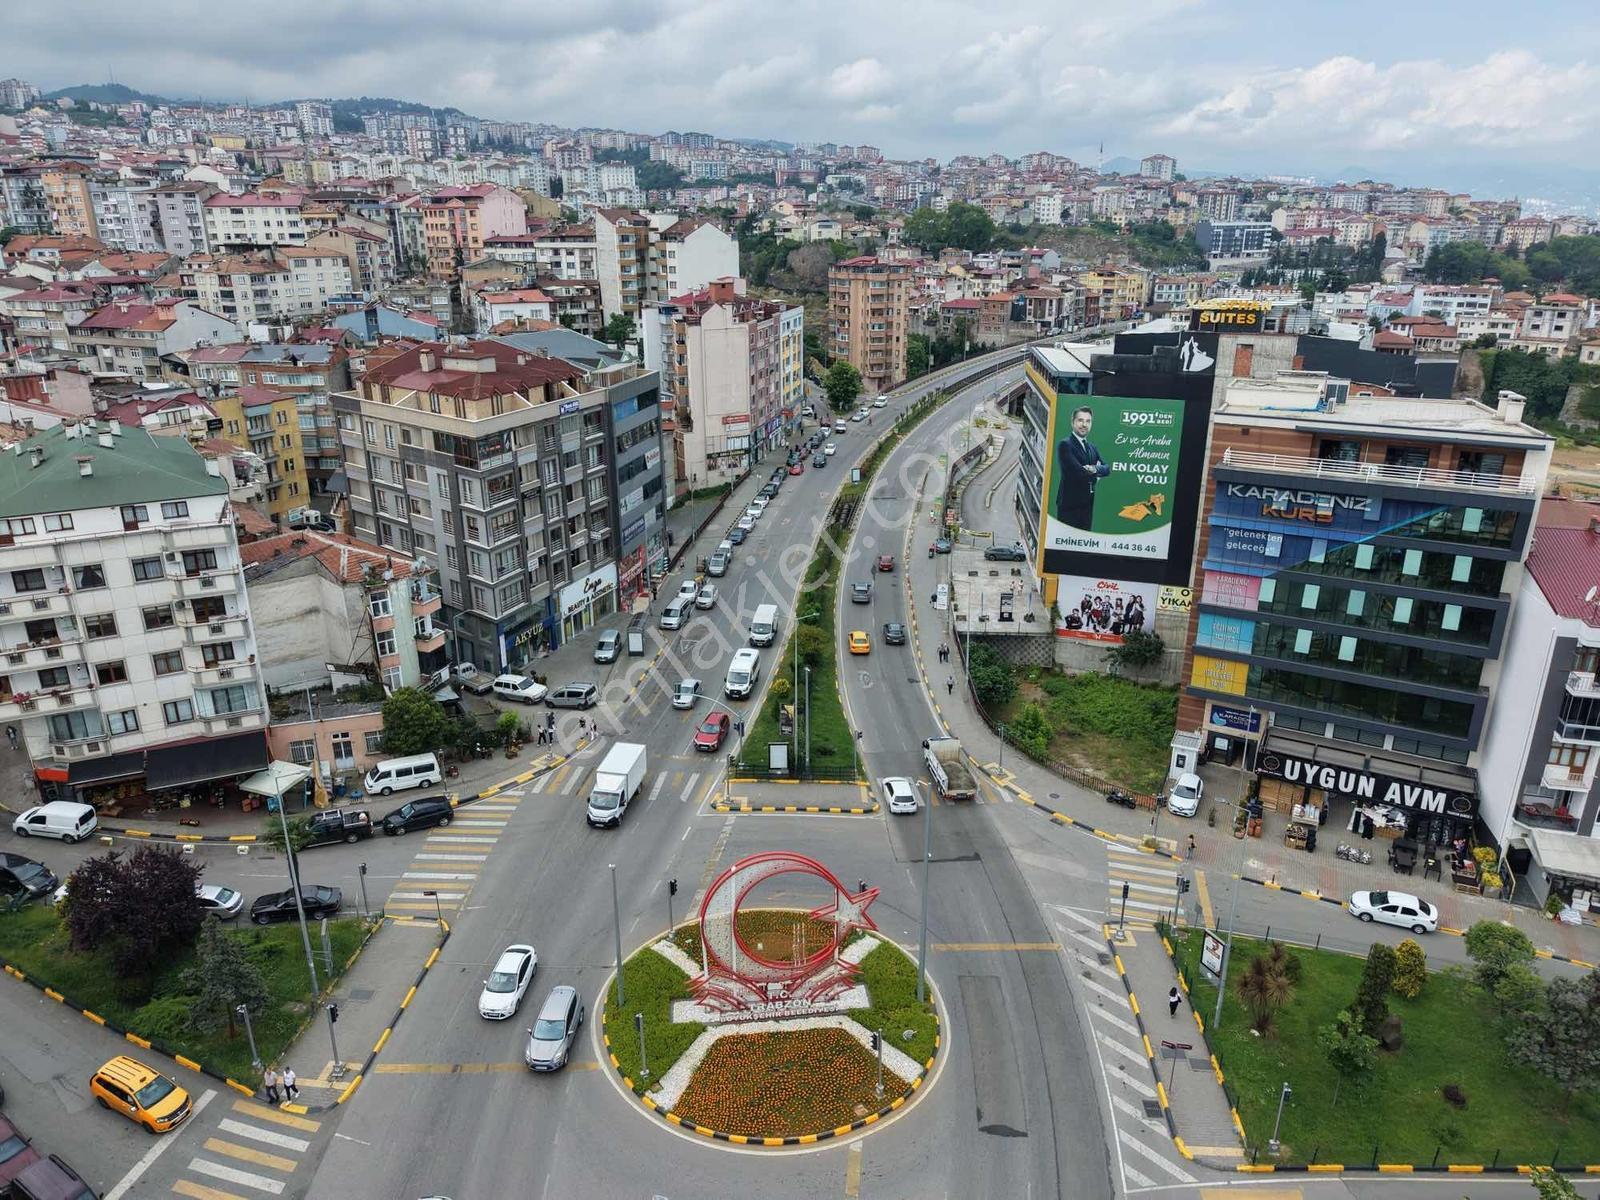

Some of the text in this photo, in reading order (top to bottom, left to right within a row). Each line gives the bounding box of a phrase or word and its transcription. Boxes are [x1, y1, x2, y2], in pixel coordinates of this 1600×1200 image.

[1200, 311, 1257, 325] SUITES
[1114, 433, 1172, 446] Ev ve Araba
[1112, 461, 1169, 474] EN KOLAY
[1137, 474, 1168, 485] YOLU
[1227, 483, 1374, 512] KARADENİZ
[1262, 503, 1334, 525] KURS
[1055, 537, 1157, 553] EMİNEVİM 444 36 46
[1284, 759, 1447, 814] UYGUN AVM
[750, 999, 812, 1012] TRABZON
